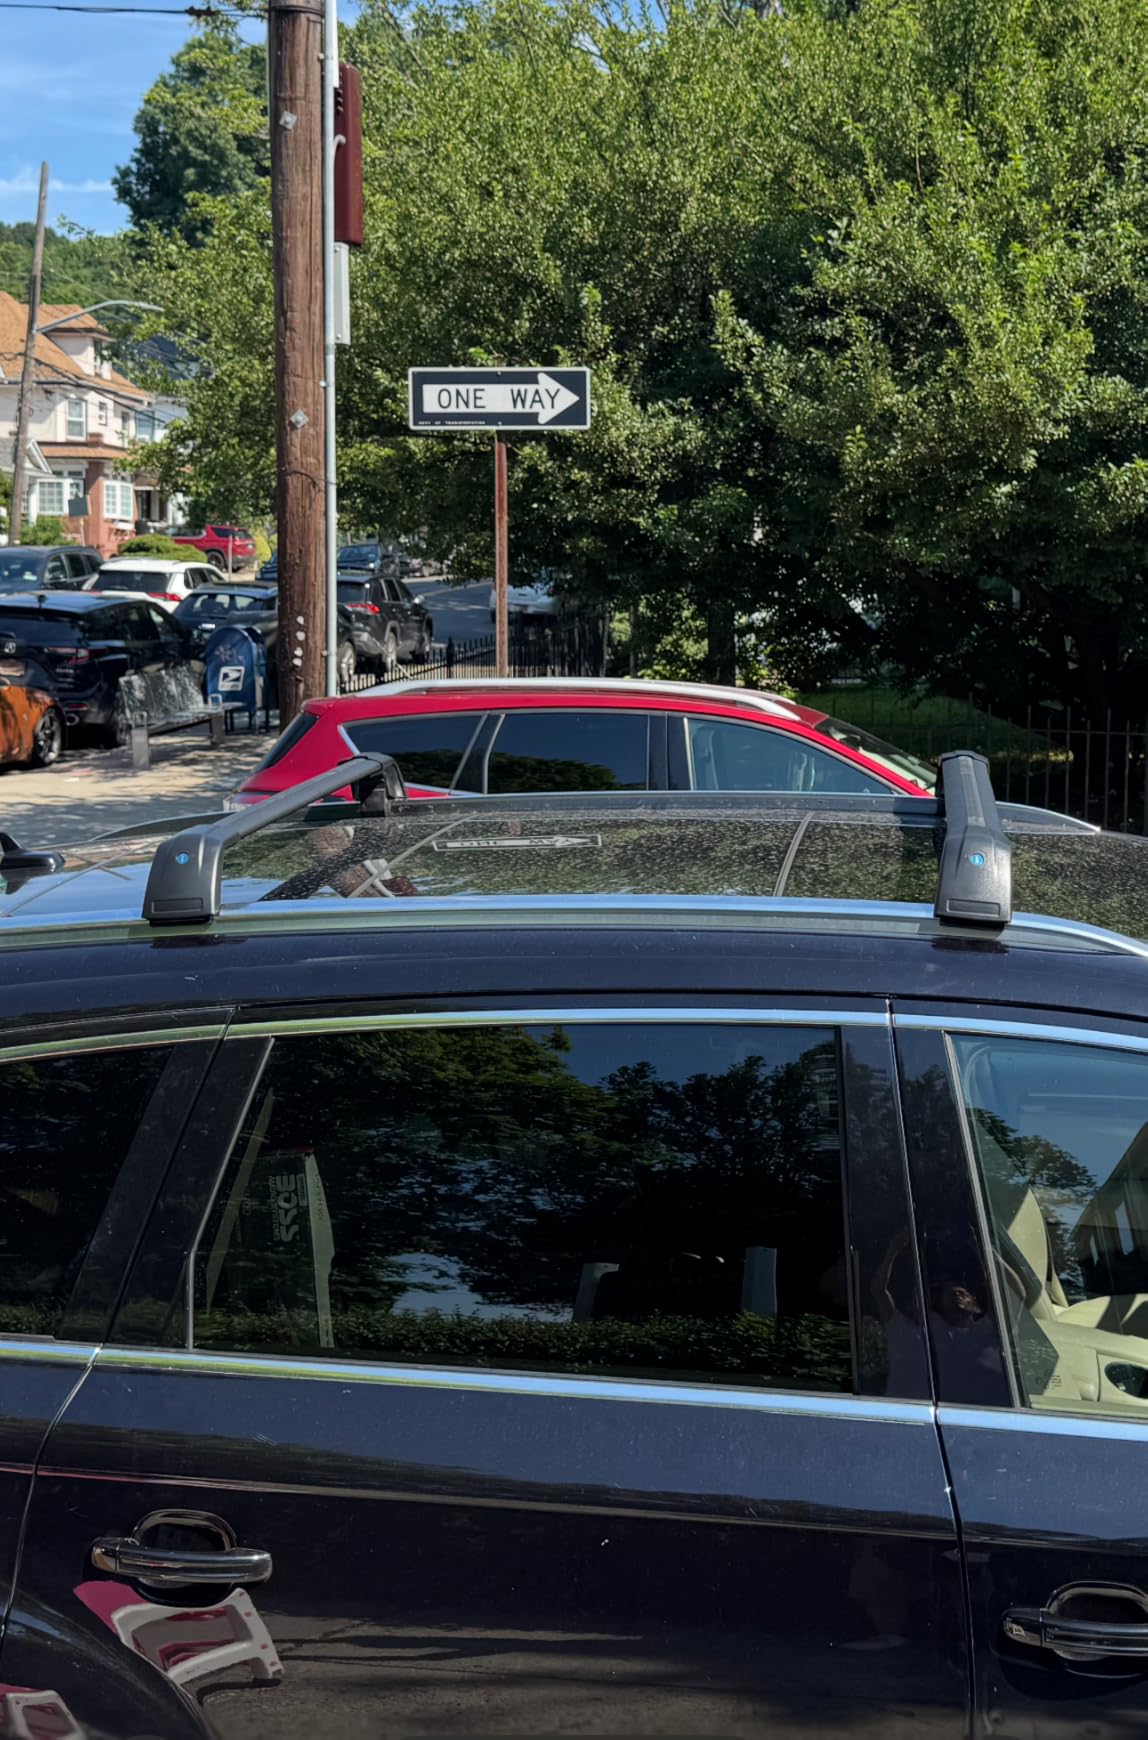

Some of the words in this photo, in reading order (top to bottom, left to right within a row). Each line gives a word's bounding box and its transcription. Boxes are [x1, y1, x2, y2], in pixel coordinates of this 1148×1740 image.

[437, 388, 486, 409] ONE
[510, 388, 561, 409] WAY
[276, 1174, 299, 1242] BOSS
